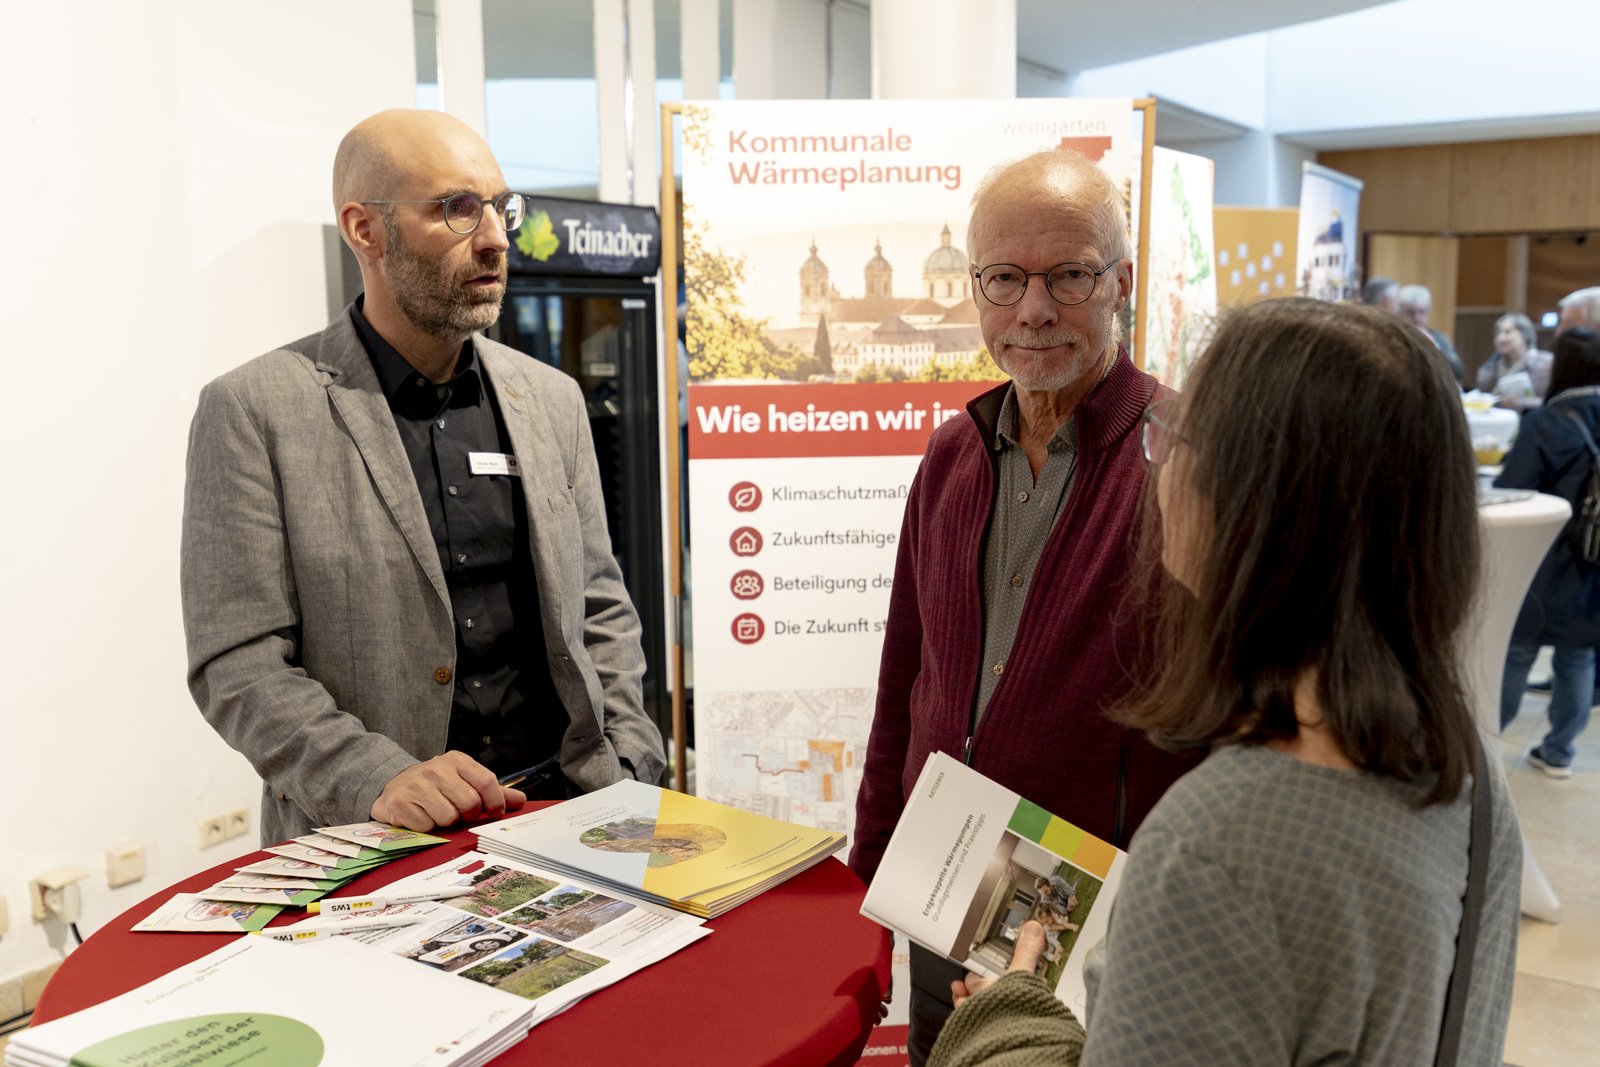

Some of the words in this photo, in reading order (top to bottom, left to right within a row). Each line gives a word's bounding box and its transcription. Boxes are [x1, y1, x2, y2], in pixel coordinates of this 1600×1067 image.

[1001, 119, 1107, 137] weingarten
[729, 128, 912, 154] Kommunale
[729, 160, 961, 190] Wärmeplanung
[562, 218, 652, 257] Teinacher
[696, 405, 761, 433] Wie
[768, 403, 868, 432] heizen
[875, 402, 926, 430] wir
[772, 485, 908, 501] Klimaschutzmaß
[772, 530, 896, 548] Zukunftsfähige
[774, 575, 867, 593] Beteiligung
[774, 620, 801, 635] Die
[806, 618, 869, 634] Zukunft
[959, 848, 969, 864] und
[964, 813, 986, 849] Praxistipps
[923, 867, 948, 916] Erdgekoppelte
[944, 814, 974, 867] Wärmepumpen
[331, 903, 351, 912] tws
[185, 1020, 222, 1038] den
[225, 1016, 256, 1034] der
